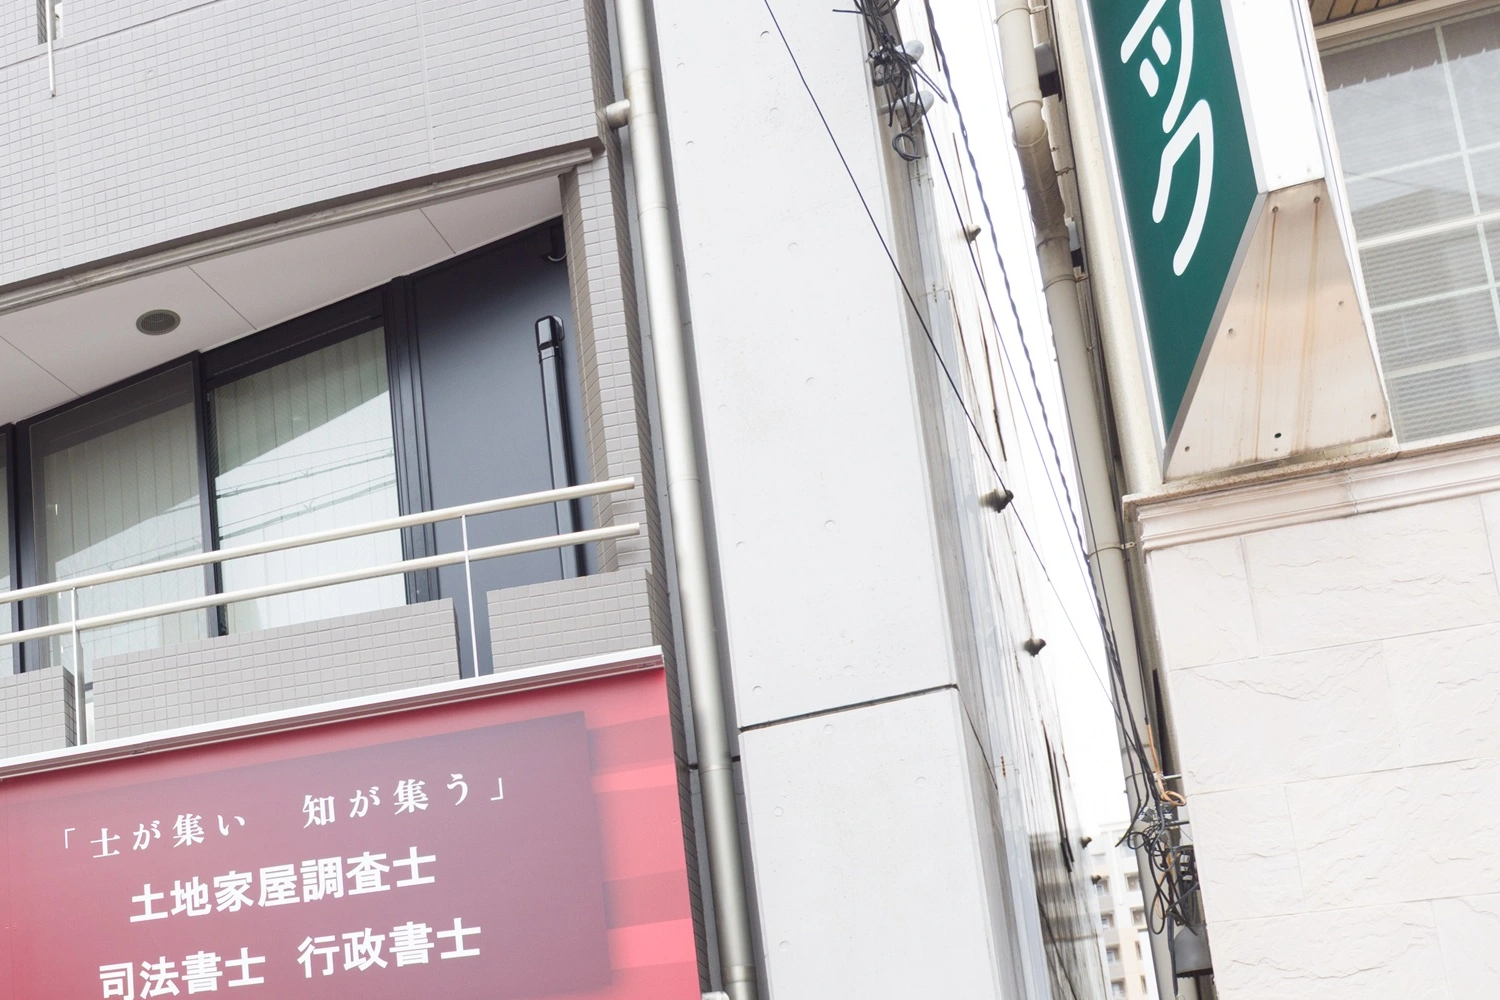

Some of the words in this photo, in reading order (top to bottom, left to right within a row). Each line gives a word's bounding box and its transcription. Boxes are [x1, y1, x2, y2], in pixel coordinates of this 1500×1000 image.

[128, 846, 437, 923] 土地家屋調査士
[297, 916, 482, 979] 行政書士
